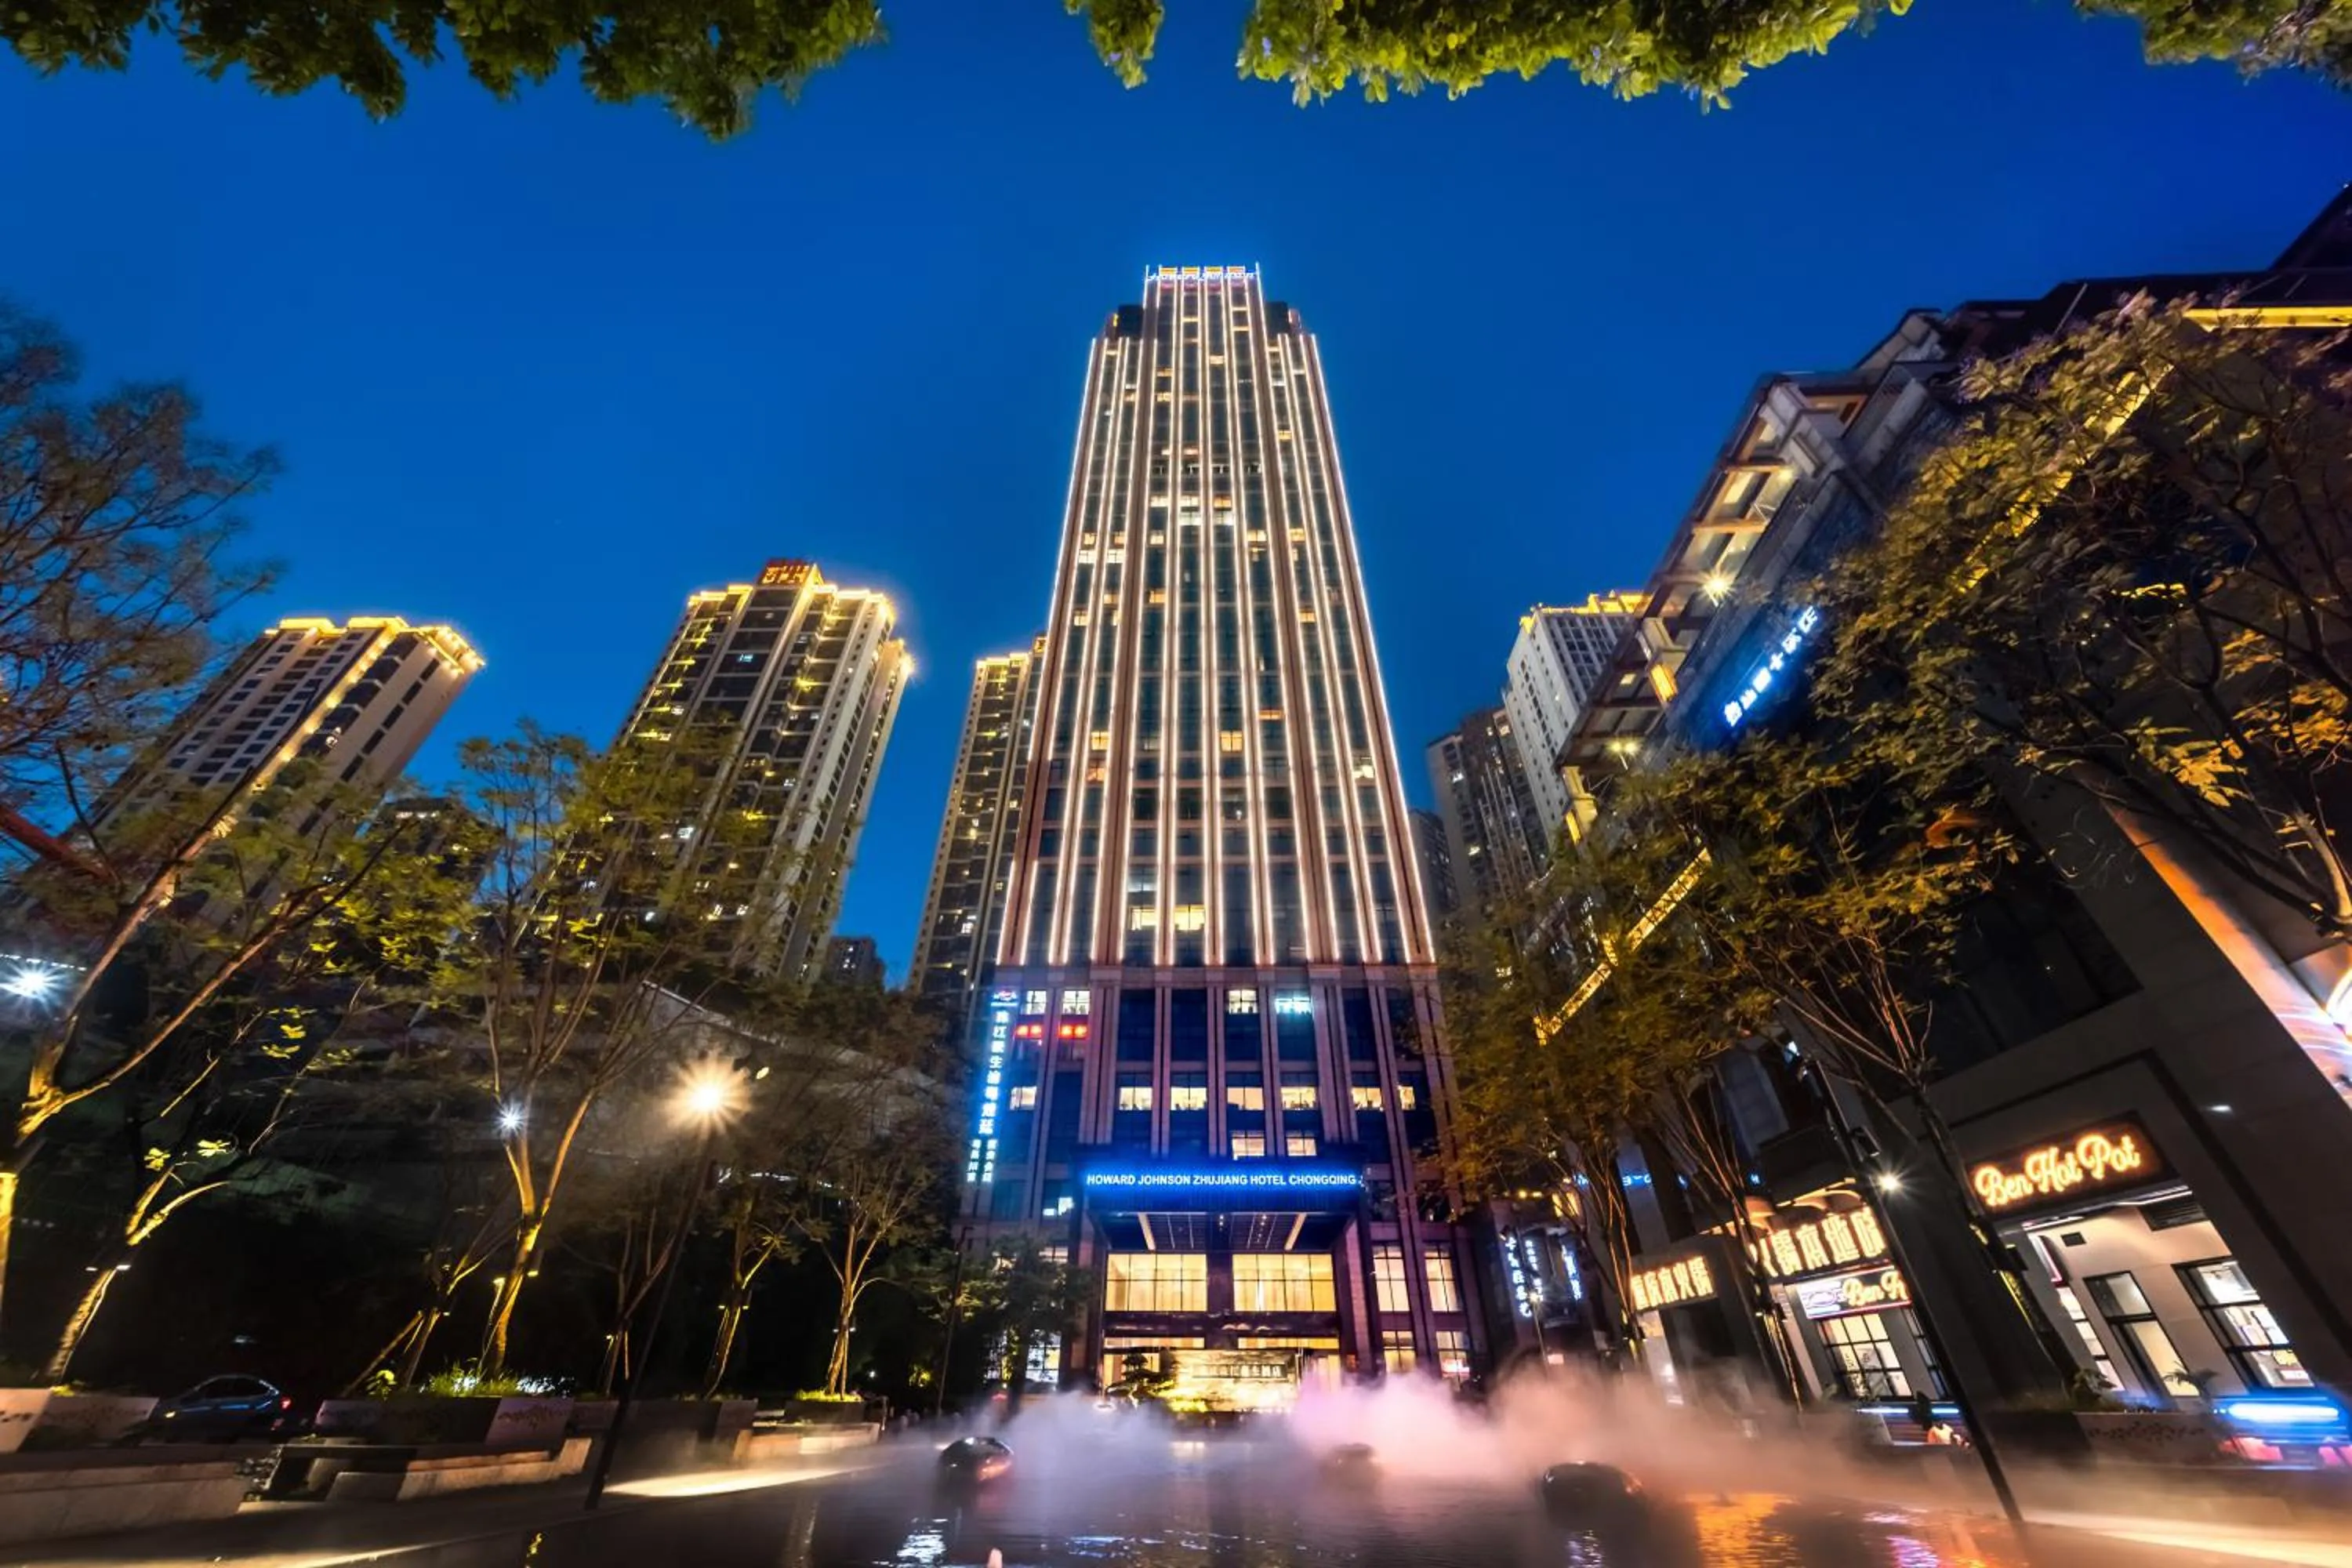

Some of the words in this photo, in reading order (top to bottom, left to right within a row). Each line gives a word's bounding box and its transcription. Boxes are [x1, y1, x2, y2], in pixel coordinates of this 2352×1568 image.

[1086, 1174, 1136, 1185] HOWARD
[1138, 1174, 1191, 1185] JOHNSON
[1192, 1174, 1248, 1185] ZHUJIANG
[1250, 1174, 1287, 1185] HOTEL
[1289, 1174, 1356, 1185] CHONGQING
[1974, 1165, 2034, 1207] Ben
[2024, 1146, 2083, 1193] Hot
[2076, 1134, 2141, 1181] Pot
[1842, 1277, 1885, 1307] Ben
